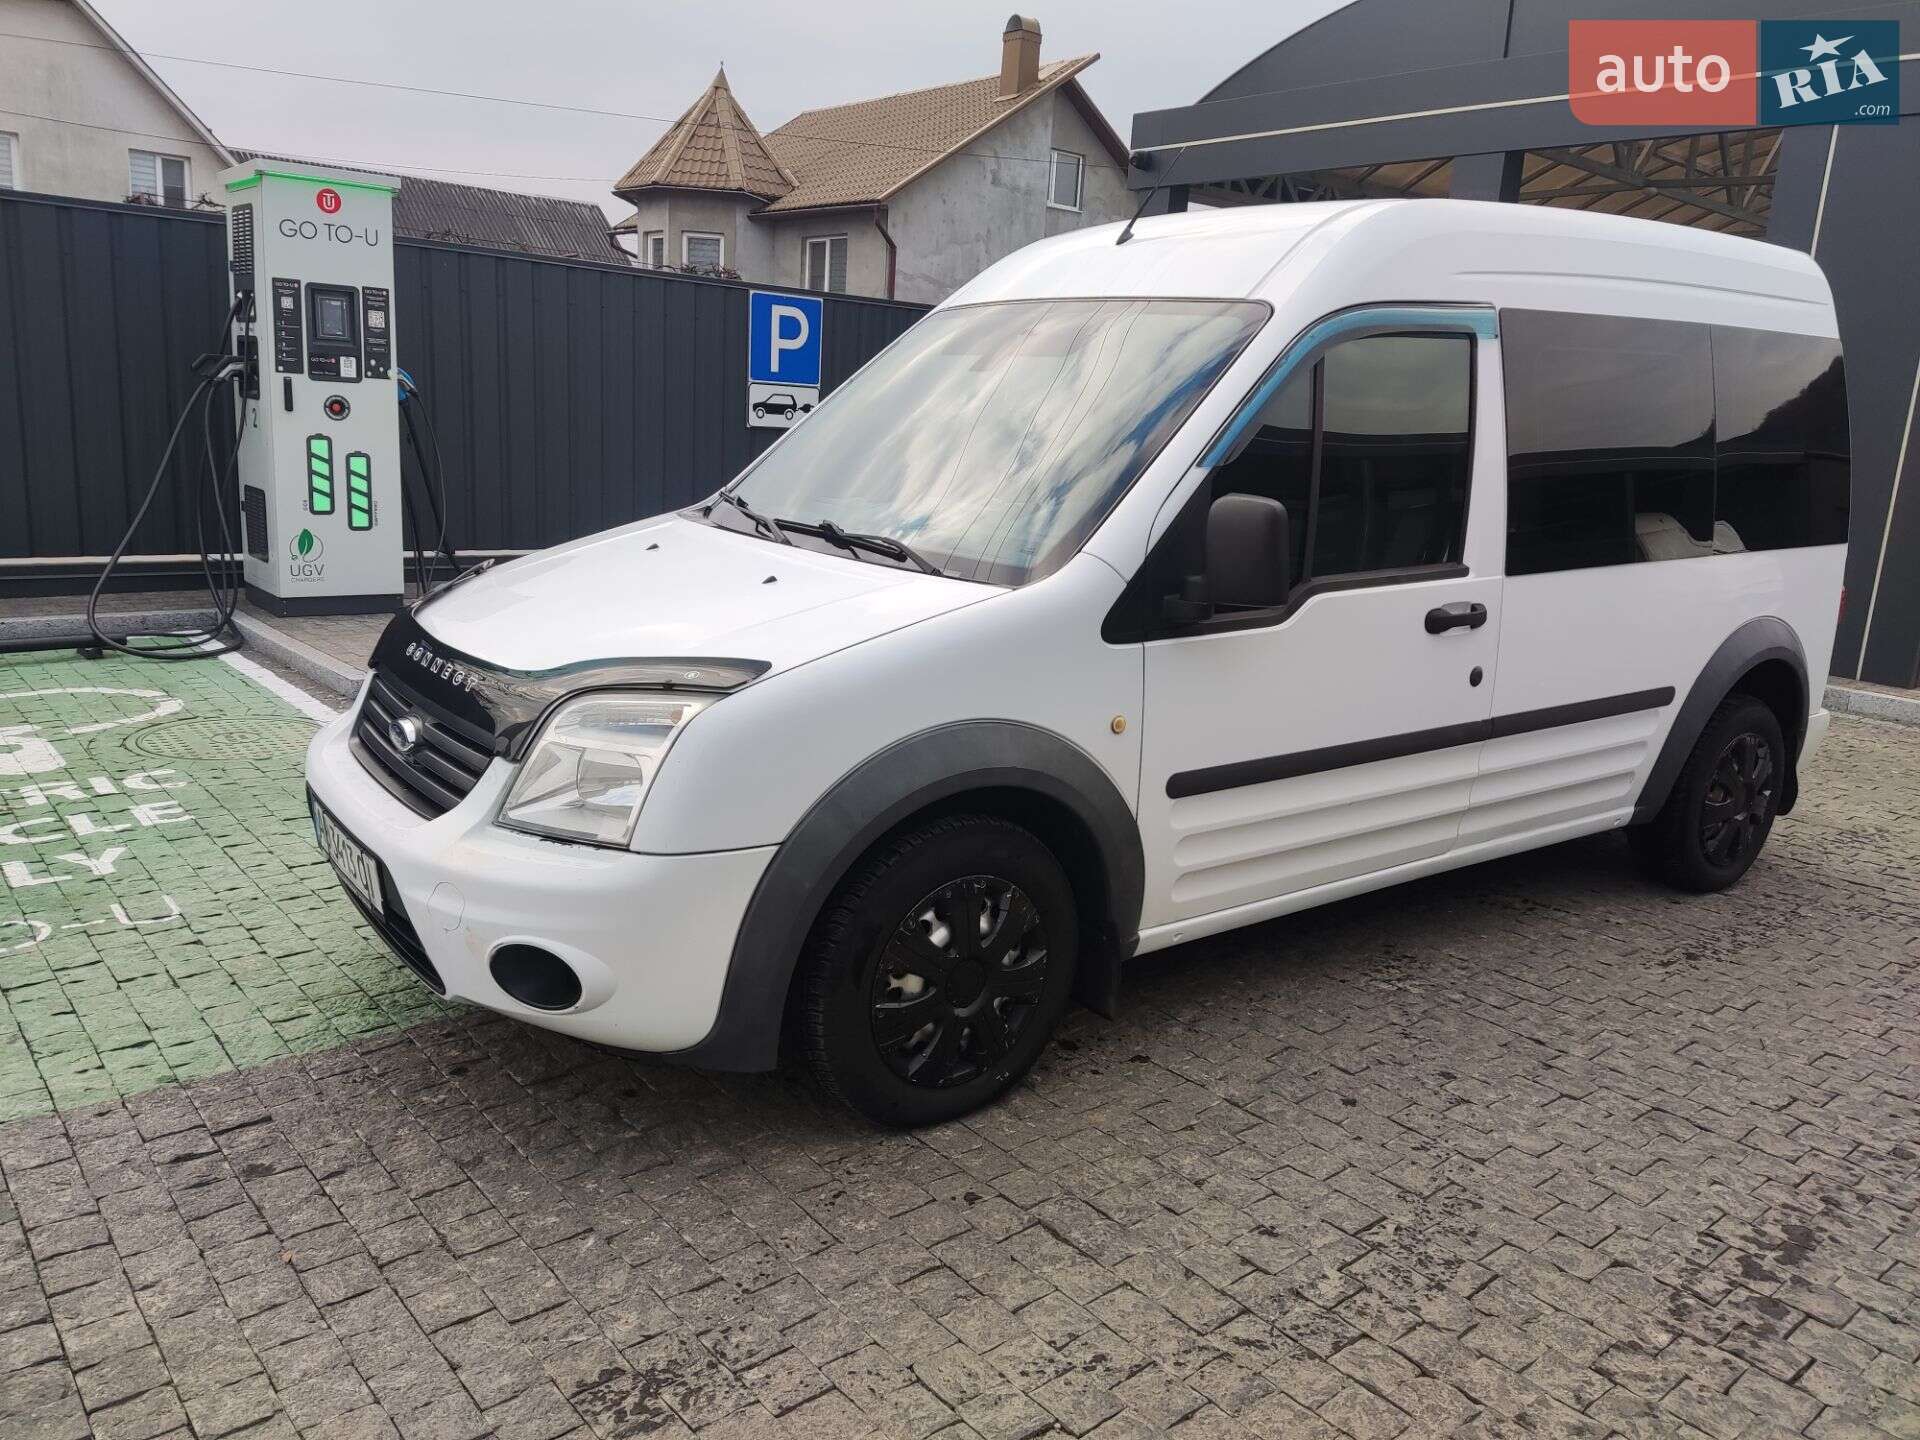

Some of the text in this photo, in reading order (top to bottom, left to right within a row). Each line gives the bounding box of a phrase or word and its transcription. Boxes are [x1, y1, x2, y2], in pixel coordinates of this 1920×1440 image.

[279, 218, 379, 247] GO TO-U
[770, 304, 809, 372] P
[290, 564, 325, 577] UGV
[405, 642, 478, 692] CONNECT
[0, 769, 188, 806] RIC
[1, 844, 128, 888] LY
